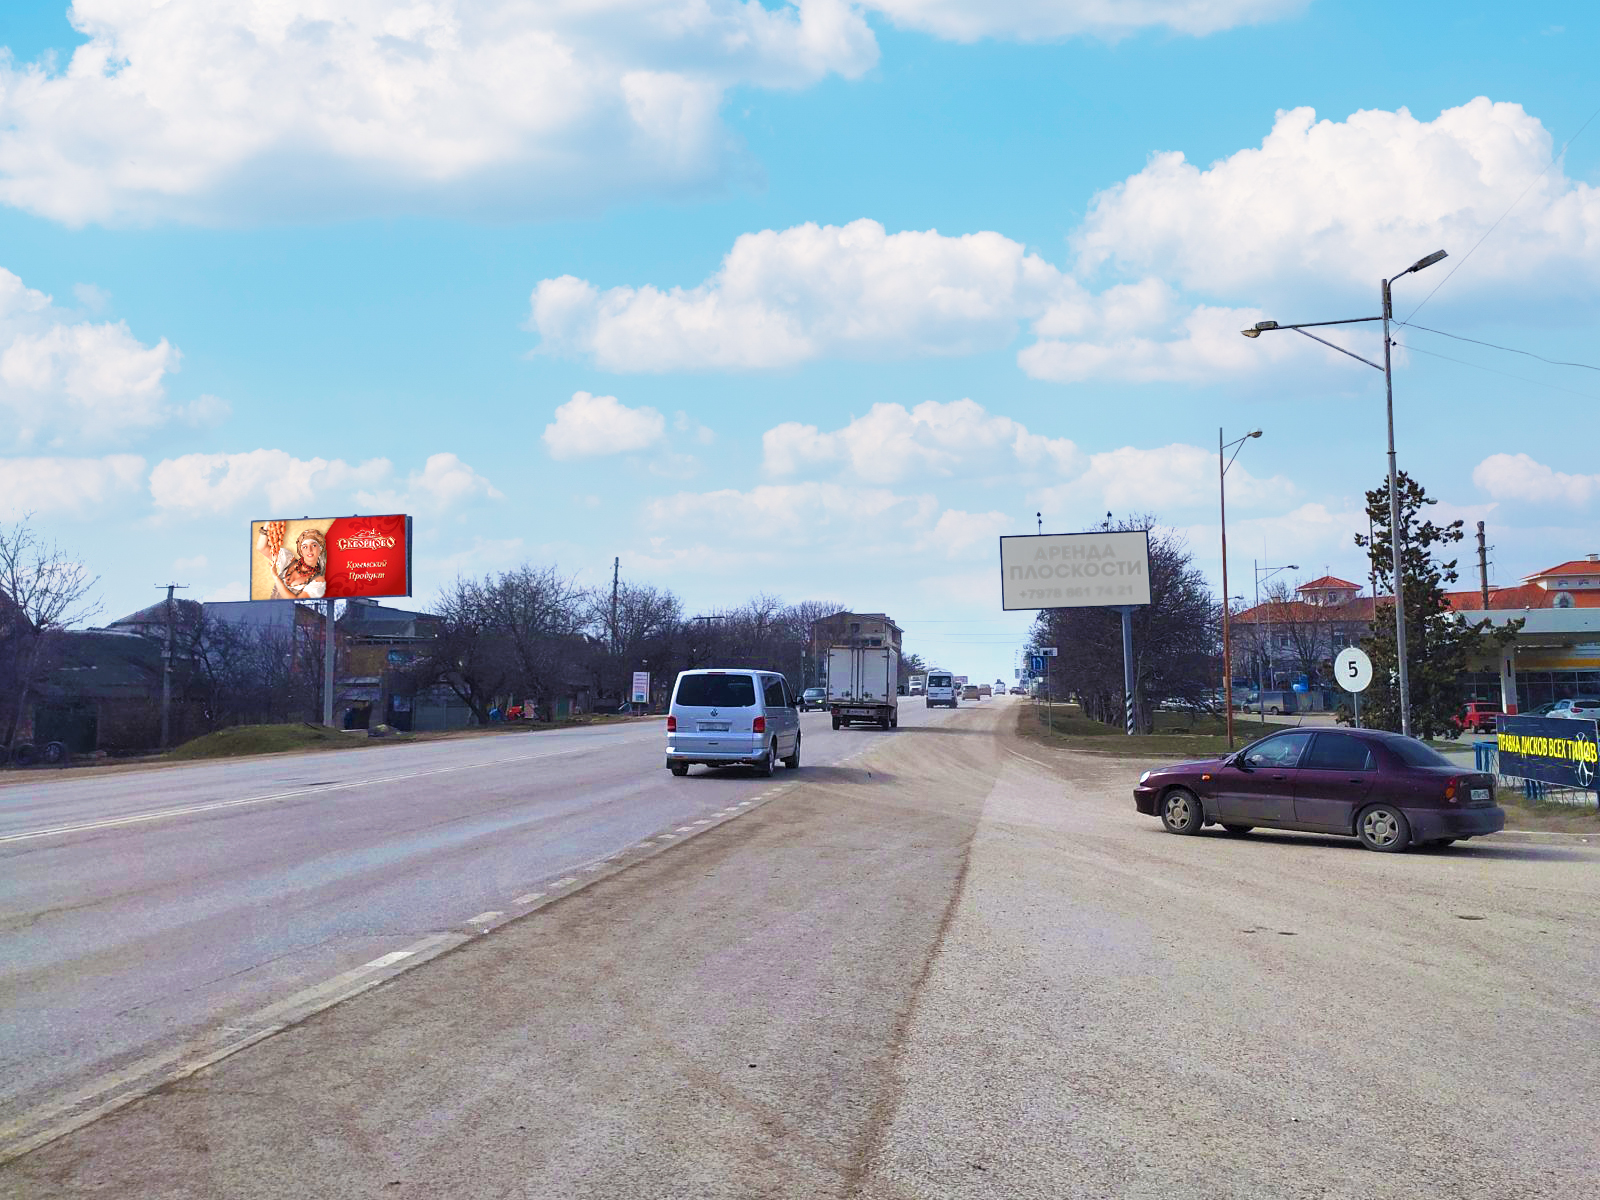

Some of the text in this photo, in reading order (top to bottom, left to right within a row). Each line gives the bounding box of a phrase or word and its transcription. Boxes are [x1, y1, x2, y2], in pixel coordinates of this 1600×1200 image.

[1034, 544, 1116, 561] АРЕНДА
[346, 560, 387, 570] Крымский
[1009, 560, 1142, 580] ПЛОСКОСТИ
[348, 571, 385, 581] Продукт
[1019, 588, 1062, 600] +7978
[1096, 585, 1114, 597] 74
[1117, 584, 1133, 596] 21
[1348, 660, 1359, 678] 5
[1497, 733, 1598, 763] ПРАВКА ДИСКОВ ВСЕХ ТИПОВ
